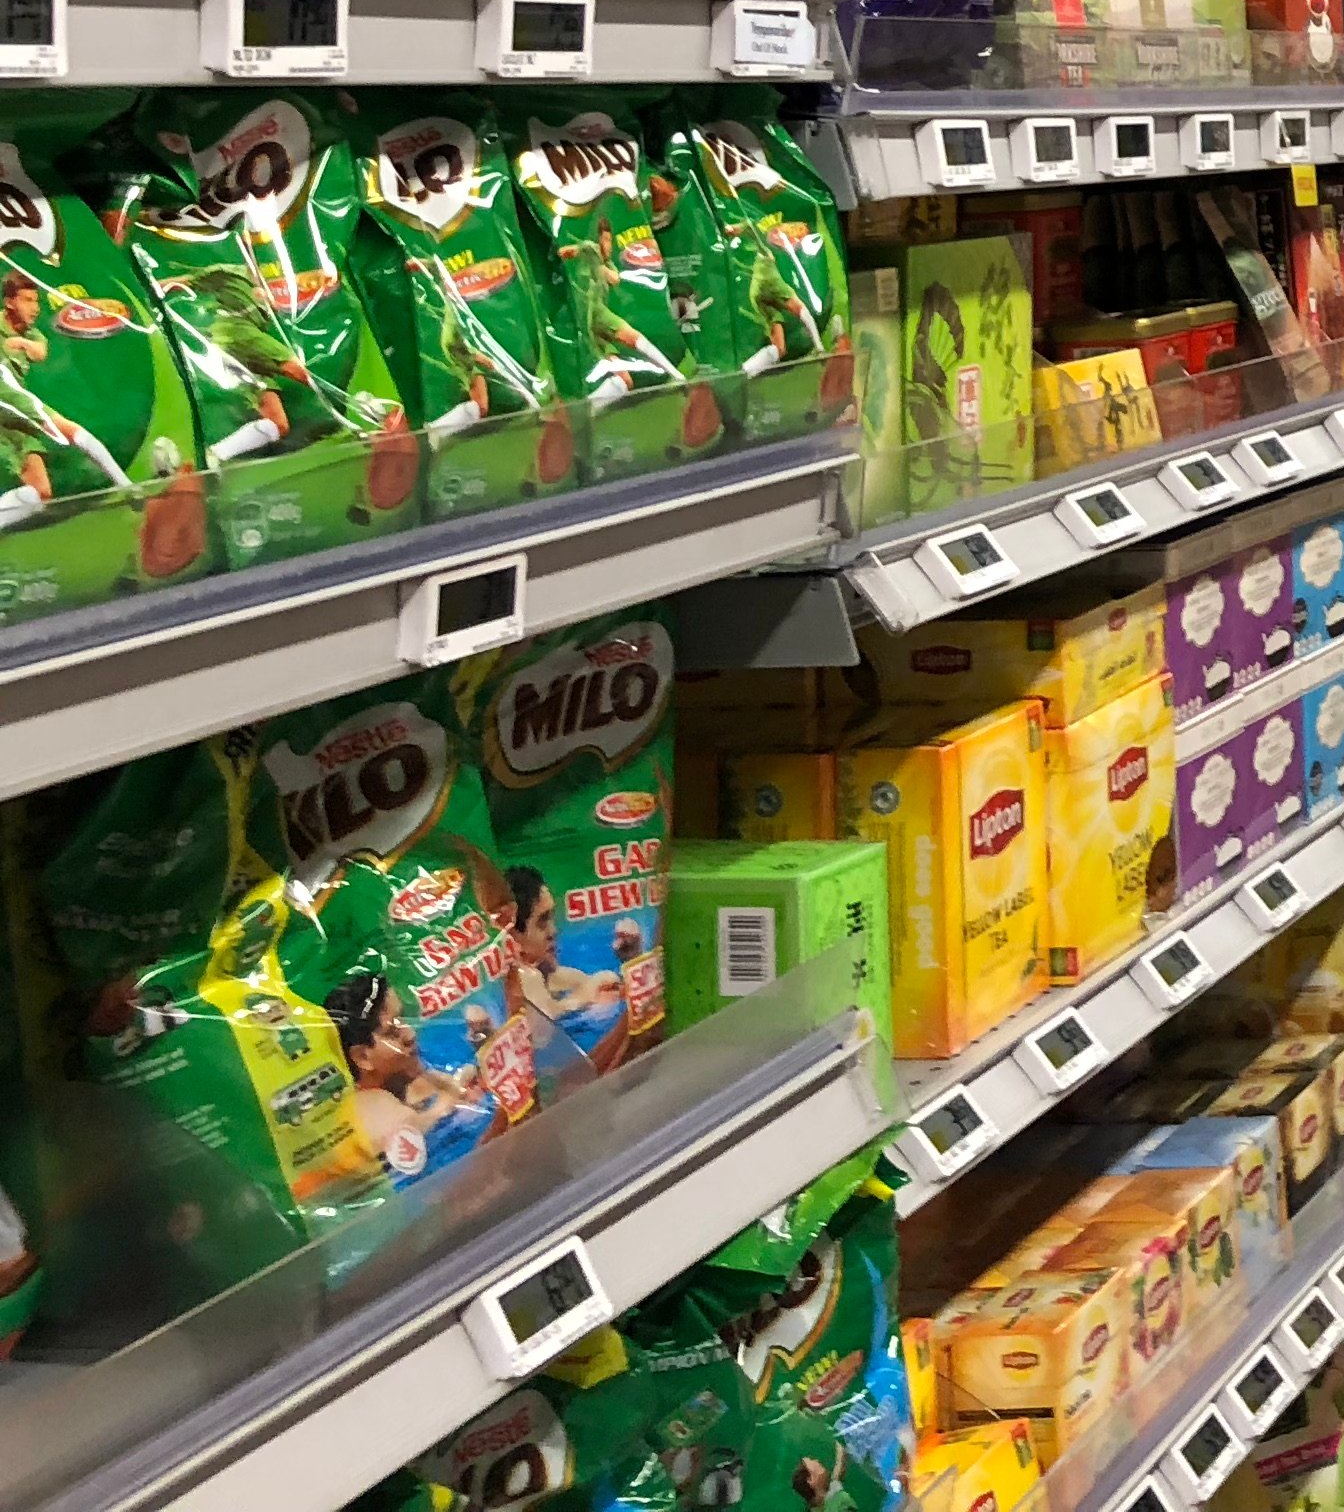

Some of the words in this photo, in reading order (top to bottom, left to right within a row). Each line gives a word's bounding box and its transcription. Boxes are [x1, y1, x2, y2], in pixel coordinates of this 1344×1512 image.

[540, 137, 638, 188] MILO
[509, 659, 660, 753] MILO
[1112, 754, 1147, 792] Lipton
[973, 797, 1022, 847] Lipton
[565, 879, 641, 922] SIEW
[964, 906, 1004, 942] YELLOW
